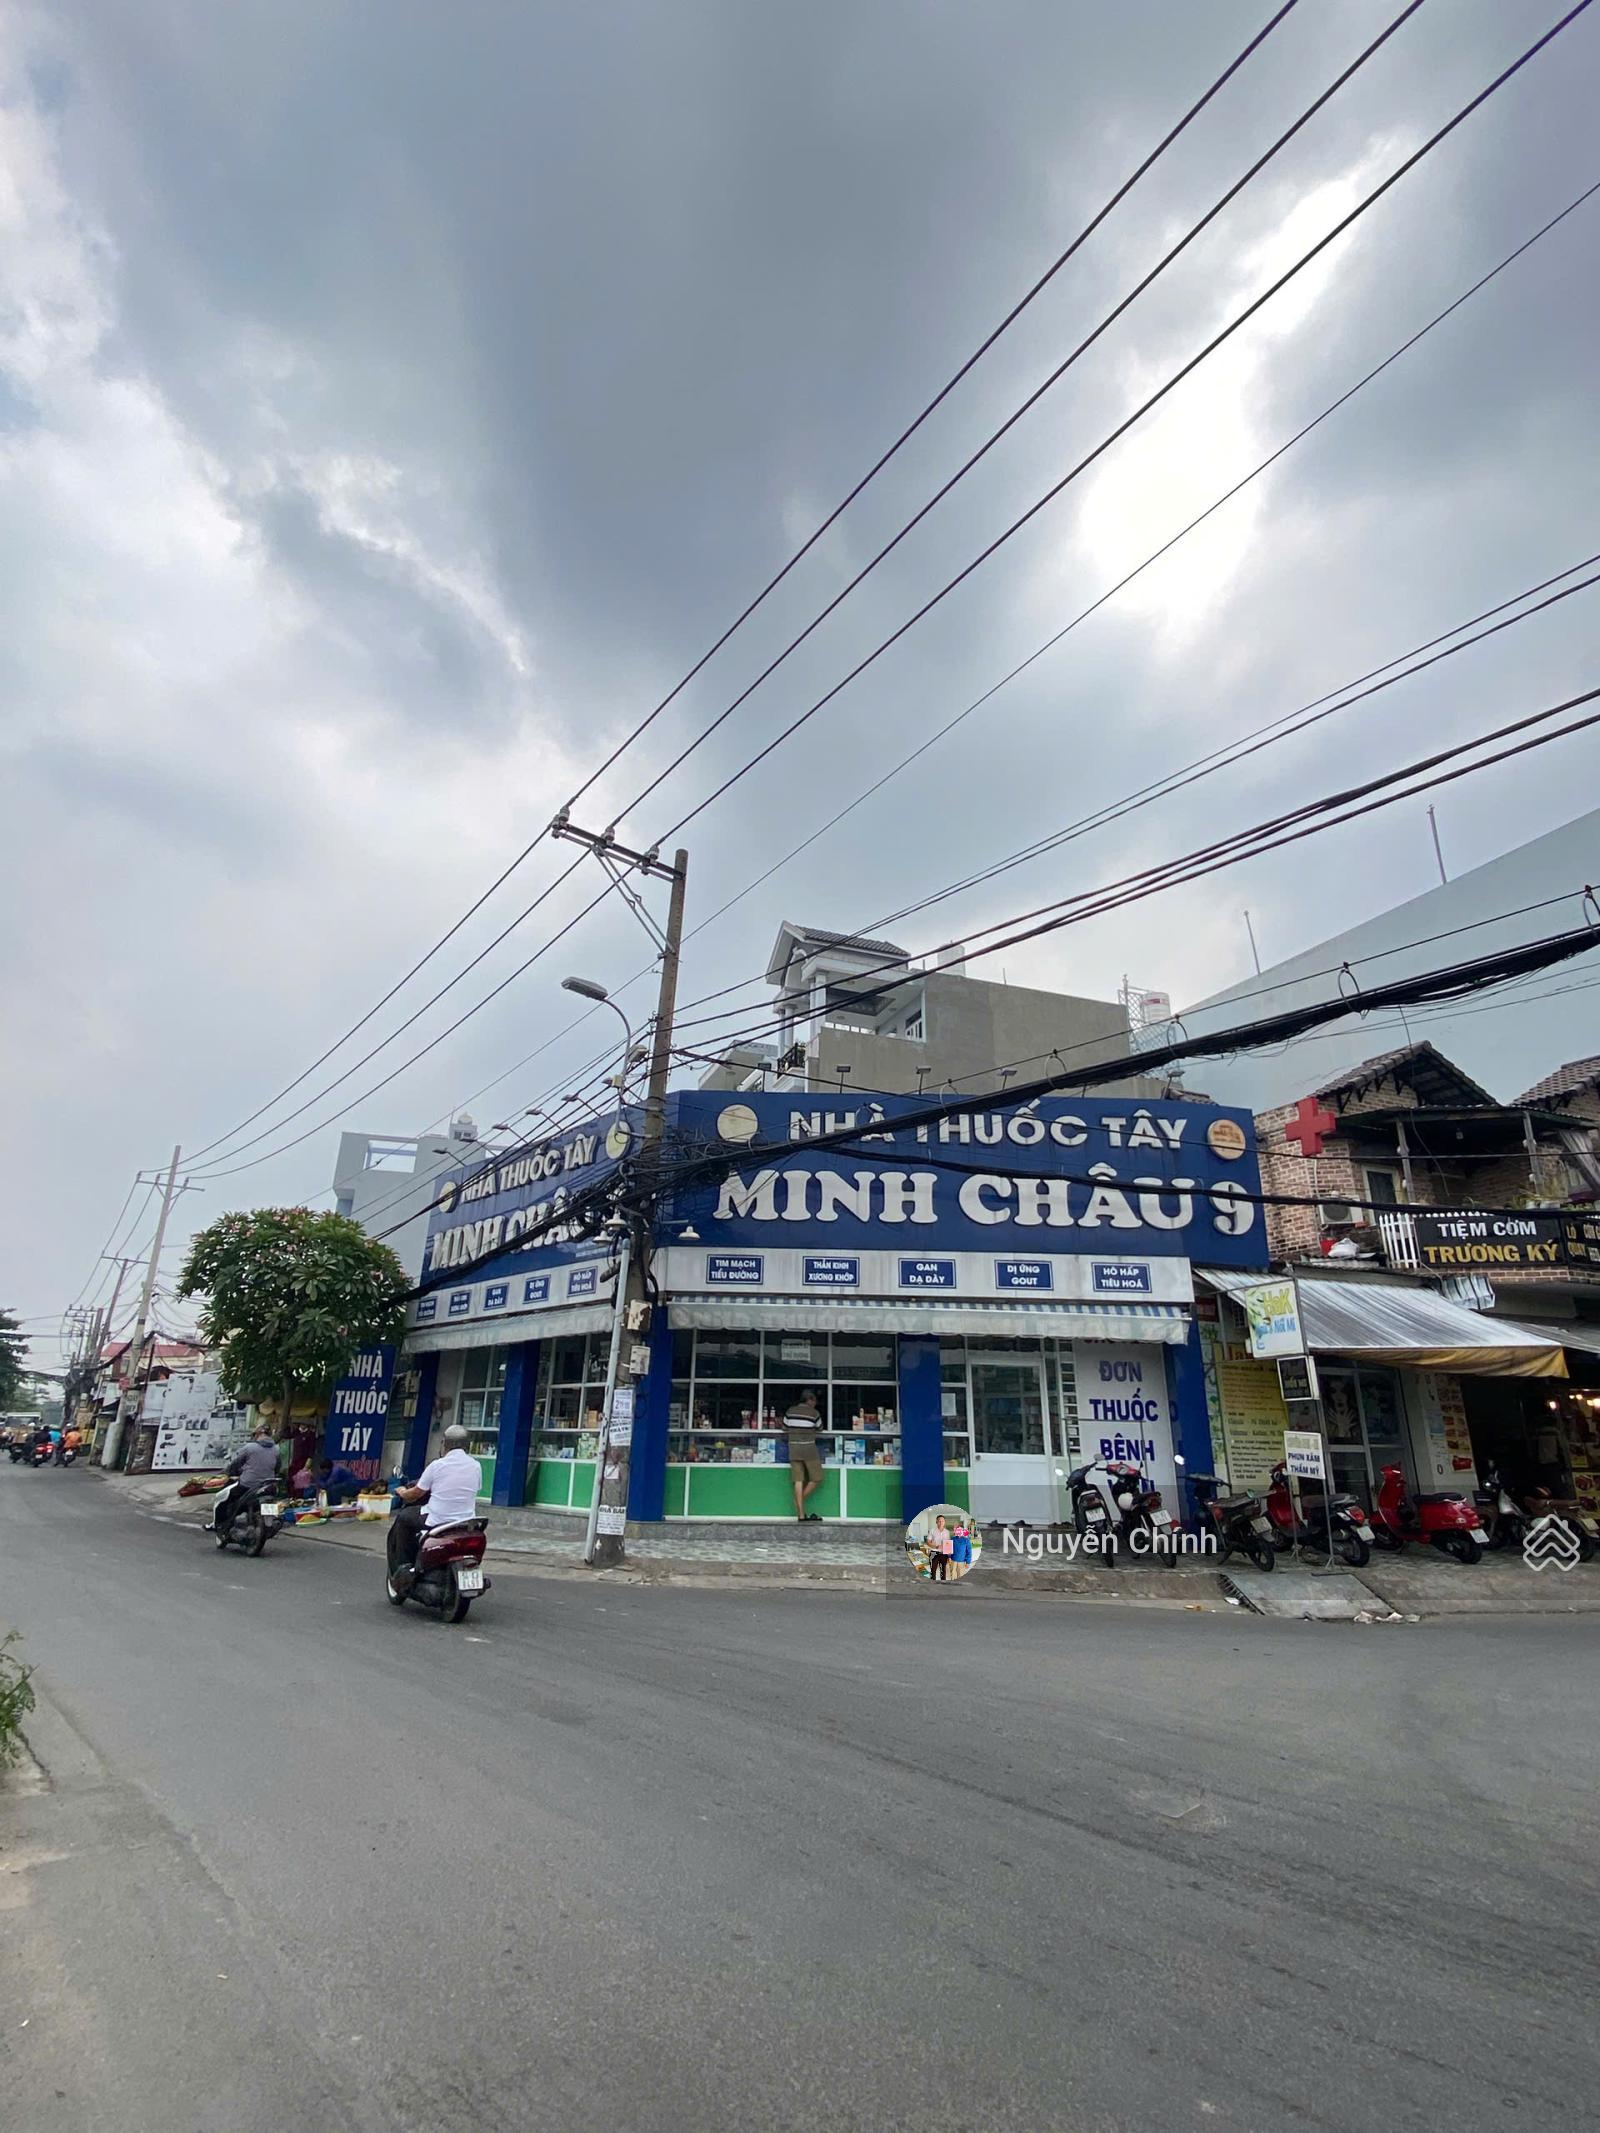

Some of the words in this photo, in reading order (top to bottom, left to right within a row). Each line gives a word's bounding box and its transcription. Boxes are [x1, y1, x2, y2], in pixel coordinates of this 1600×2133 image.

[1102, 1109, 1188, 1150] TÂY
[461, 1164, 497, 1204] NHÀ
[499, 1143, 561, 1192] THUỐC
[564, 1133, 599, 1171] TÂY
[712, 1169, 939, 1224] MINH
[958, 1162, 1196, 1230] CHÂU
[1210, 1181, 1255, 1236] 9
[1437, 1219, 1488, 1240] TIỆM
[1493, 1219, 1537, 1236] CƠM
[429, 1214, 506, 1272] MINH
[1423, 1243, 1521, 1263] TRƯƠNG
[1526, 1239, 1558, 1262] KÝ
[715, 1260, 729, 1268] TIM
[731, 1260, 756, 1270] MẠCH
[916, 1263, 938, 1271] GAN
[1006, 1265, 1017, 1275] DỊ
[1019, 1263, 1041, 1274] ỨNG
[1102, 1266, 1118, 1275] HÔ
[1119, 1265, 1140, 1276] HẤP
[909, 1275, 923, 1286] DẠ
[925, 1273, 945, 1283] DÀY
[1011, 1277, 1039, 1285] GOUT
[1122, 1278, 1144, 1288] HOÁ
[348, 1350, 383, 1378] NHÀ
[1098, 1360, 1143, 1382] ĐƠN
[335, 1380, 389, 1415] THUỐC
[1089, 1387, 1159, 1422] THUỐC
[341, 1422, 373, 1452] TÂY
